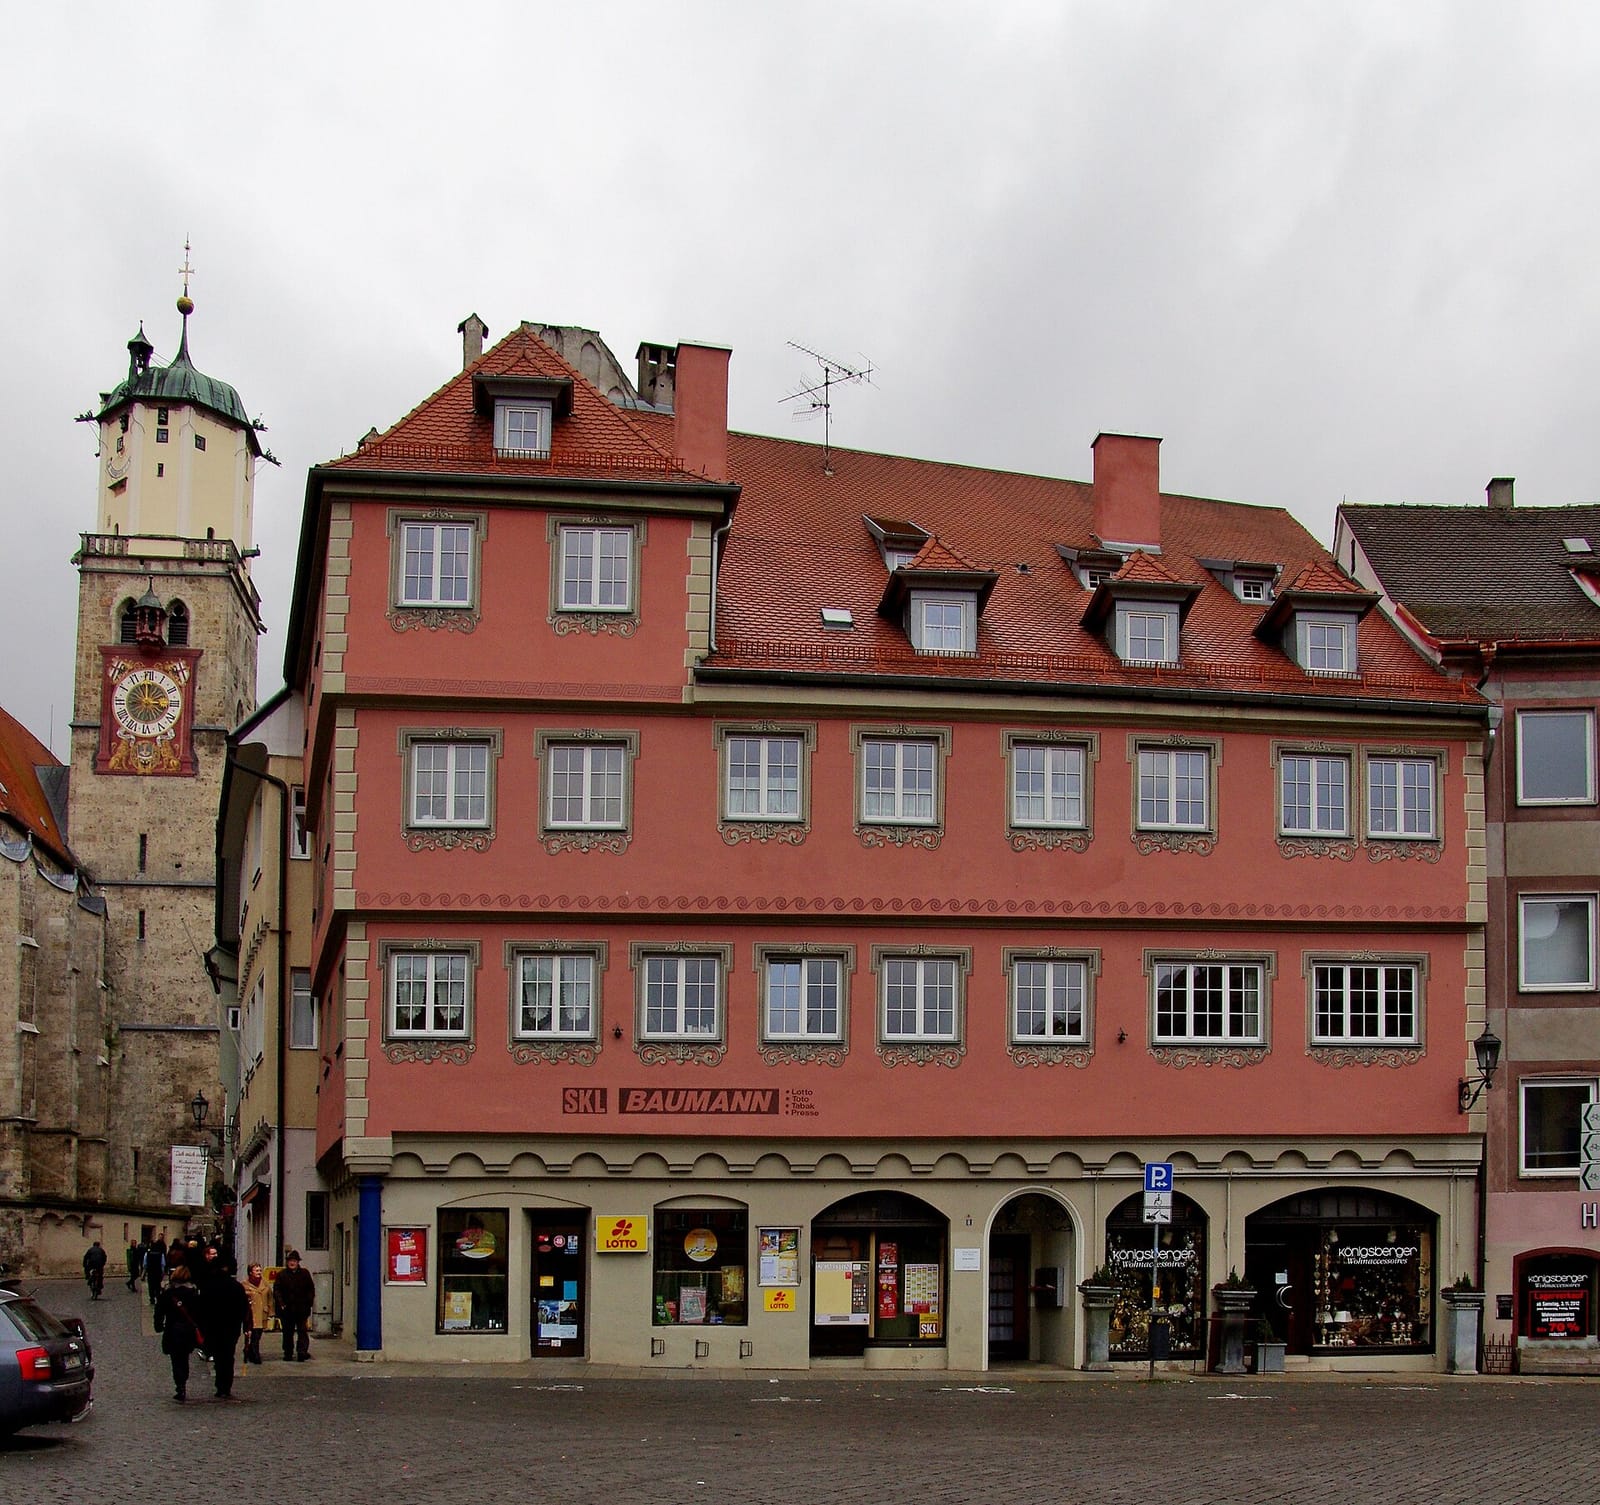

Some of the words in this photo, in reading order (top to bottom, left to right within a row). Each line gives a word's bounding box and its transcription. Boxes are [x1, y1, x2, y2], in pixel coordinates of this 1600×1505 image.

[167, 686, 177, 694] II
[169, 700, 180, 708] III
[116, 709, 129, 724] VIII
[126, 719, 137, 732] VII
[142, 724, 151, 734] VI
[158, 723, 165, 732] V
[564, 1089, 606, 1113] SKL
[625, 1090, 773, 1113] BAUMANN
[791, 1109, 820, 1117] Presse
[1151, 1167, 1167, 1188] P
[1581, 1202, 1599, 1228] H
[606, 1239, 638, 1248] LOTTO
[1122, 1260, 1187, 1268] Wohnacessoires
[1347, 1257, 1408, 1265] Wohnaccessoires
[1534, 1291, 1584, 1300] Lagerverkauf
[920, 1323, 937, 1334] SKL
[1548, 1322, 1566, 1332] 70
[1567, 1322, 1581, 1332] %
